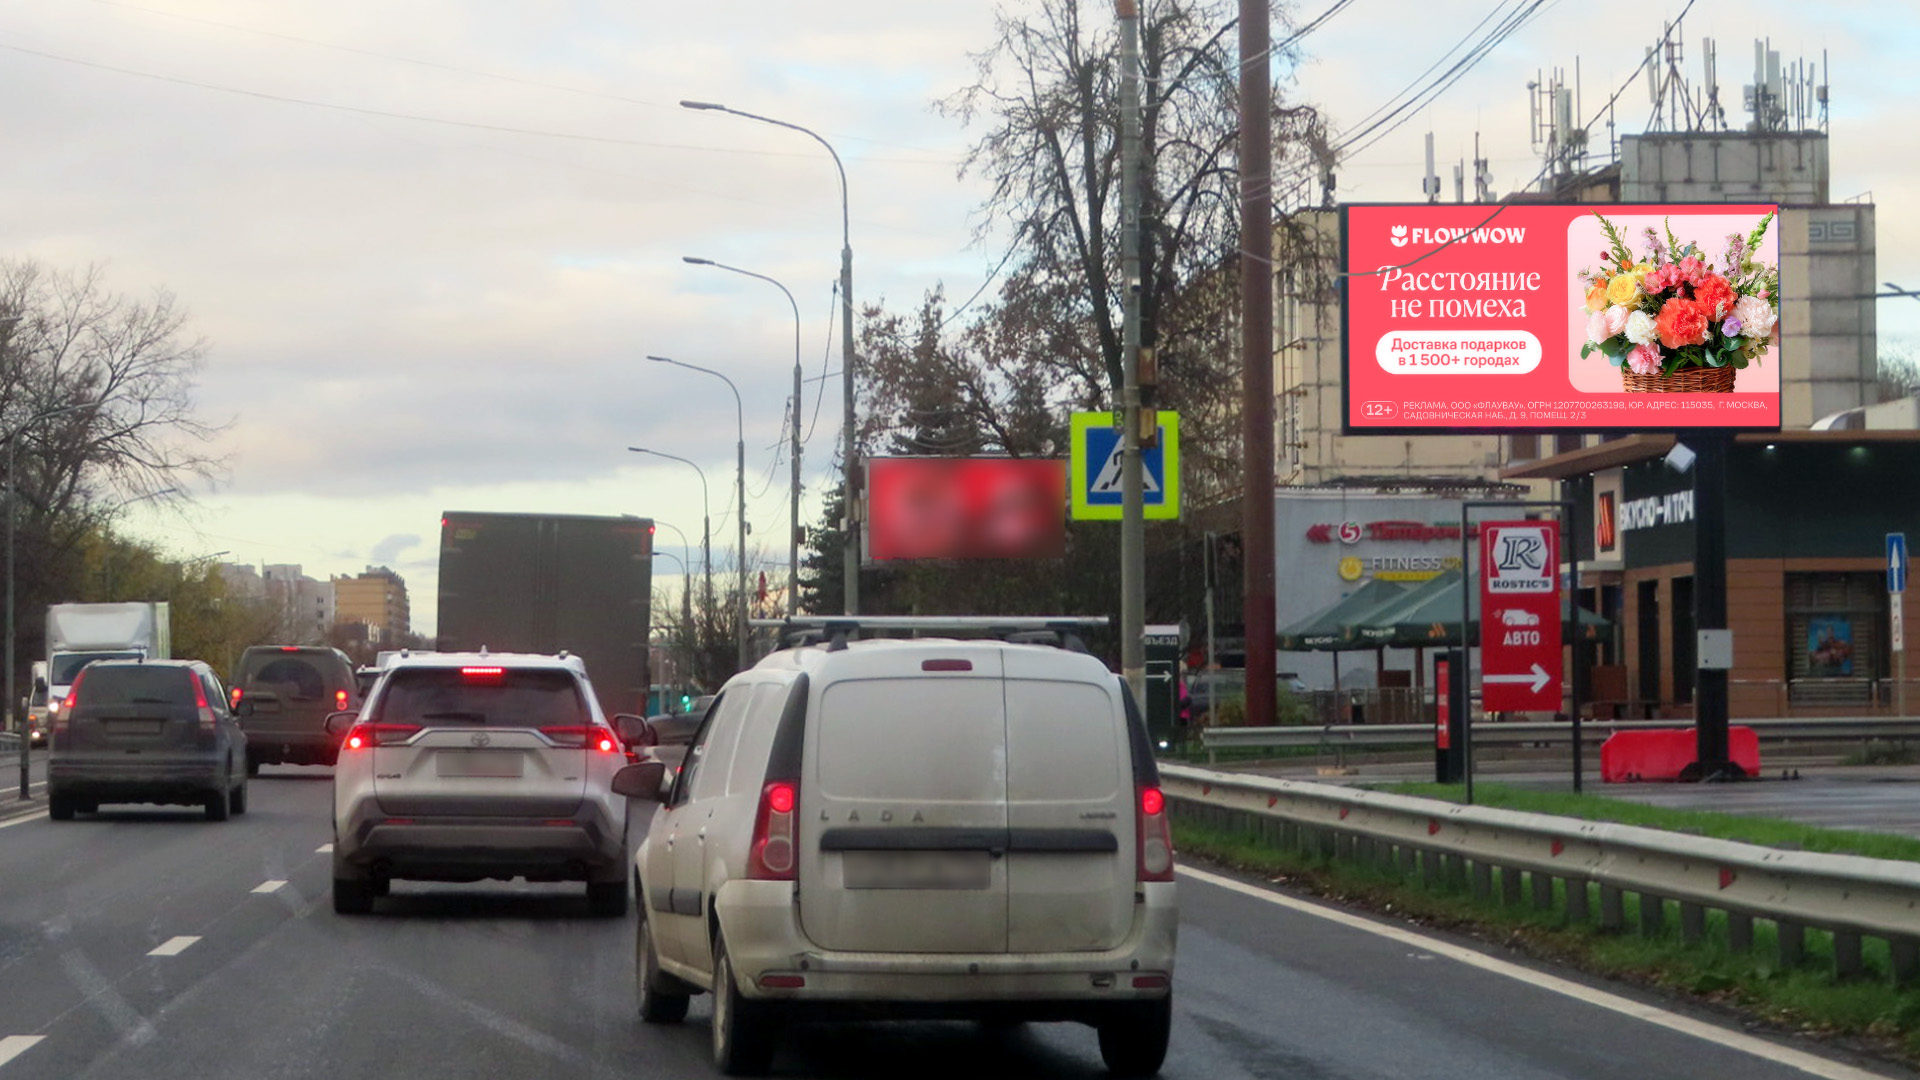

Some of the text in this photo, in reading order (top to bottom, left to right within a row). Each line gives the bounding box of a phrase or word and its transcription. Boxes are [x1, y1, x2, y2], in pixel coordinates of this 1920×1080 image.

[1412, 227, 1526, 244] FLOWWOW
[1376, 265, 1541, 291] Расстояние
[1390, 298, 1527, 318] не помеха
[1391, 337, 1527, 353] Доставка подарков
[1398, 356, 1407, 366] в
[1463, 356, 1520, 369] городах
[1366, 403, 1393, 416] 12+
[1403, 401, 1449, 410] РЕКЛАМА.
[1450, 401, 1472, 410] ООО
[1527, 401, 1552, 410] ОГРН
[1628, 401, 1645, 410] ЮР.
[1646, 401, 1679, 411] АДРЕС:
[1680, 401, 1716, 411] 115035,
[1726, 401, 1768, 411] МОСКВА,
[1403, 411, 1483, 421] САДОВНИЧЕСКАЯ
[1570, 411, 1587, 421] 2/3
[1372, 556, 1440, 569] FITNESS
[1493, 580, 1550, 589] ROSTIC'S
[1145, 636, 1179, 646] ВЪЕЗД
[1503, 631, 1540, 645] АВТО
[820, 809, 925, 823] LADA
